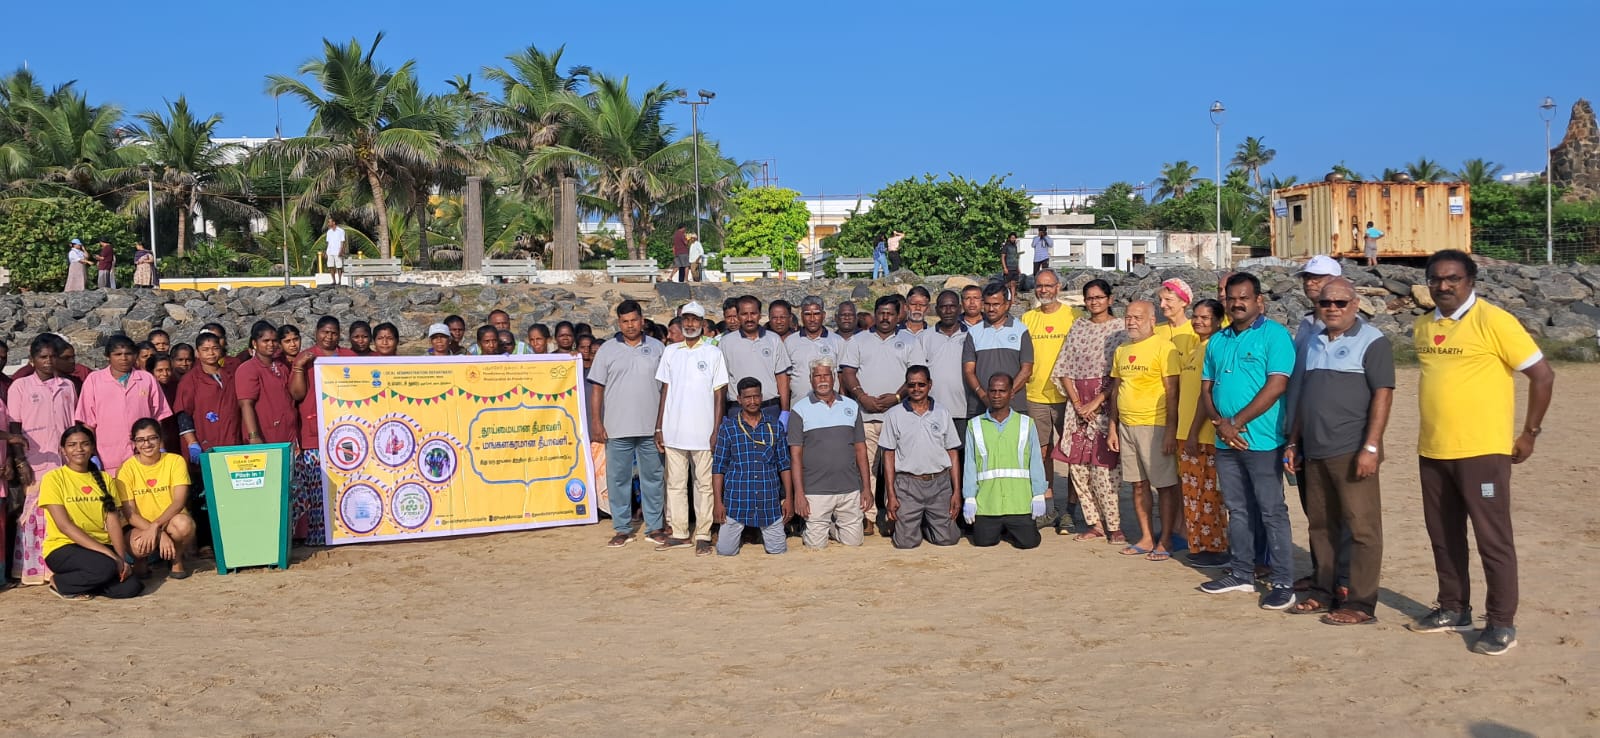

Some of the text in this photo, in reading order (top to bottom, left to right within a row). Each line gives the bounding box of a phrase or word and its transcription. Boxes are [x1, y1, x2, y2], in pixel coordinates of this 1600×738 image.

[1438, 347, 1463, 355] EARTH
[532, 421, 562, 435] தீபாவளி
[538, 435, 568, 450] தீபாவளி
